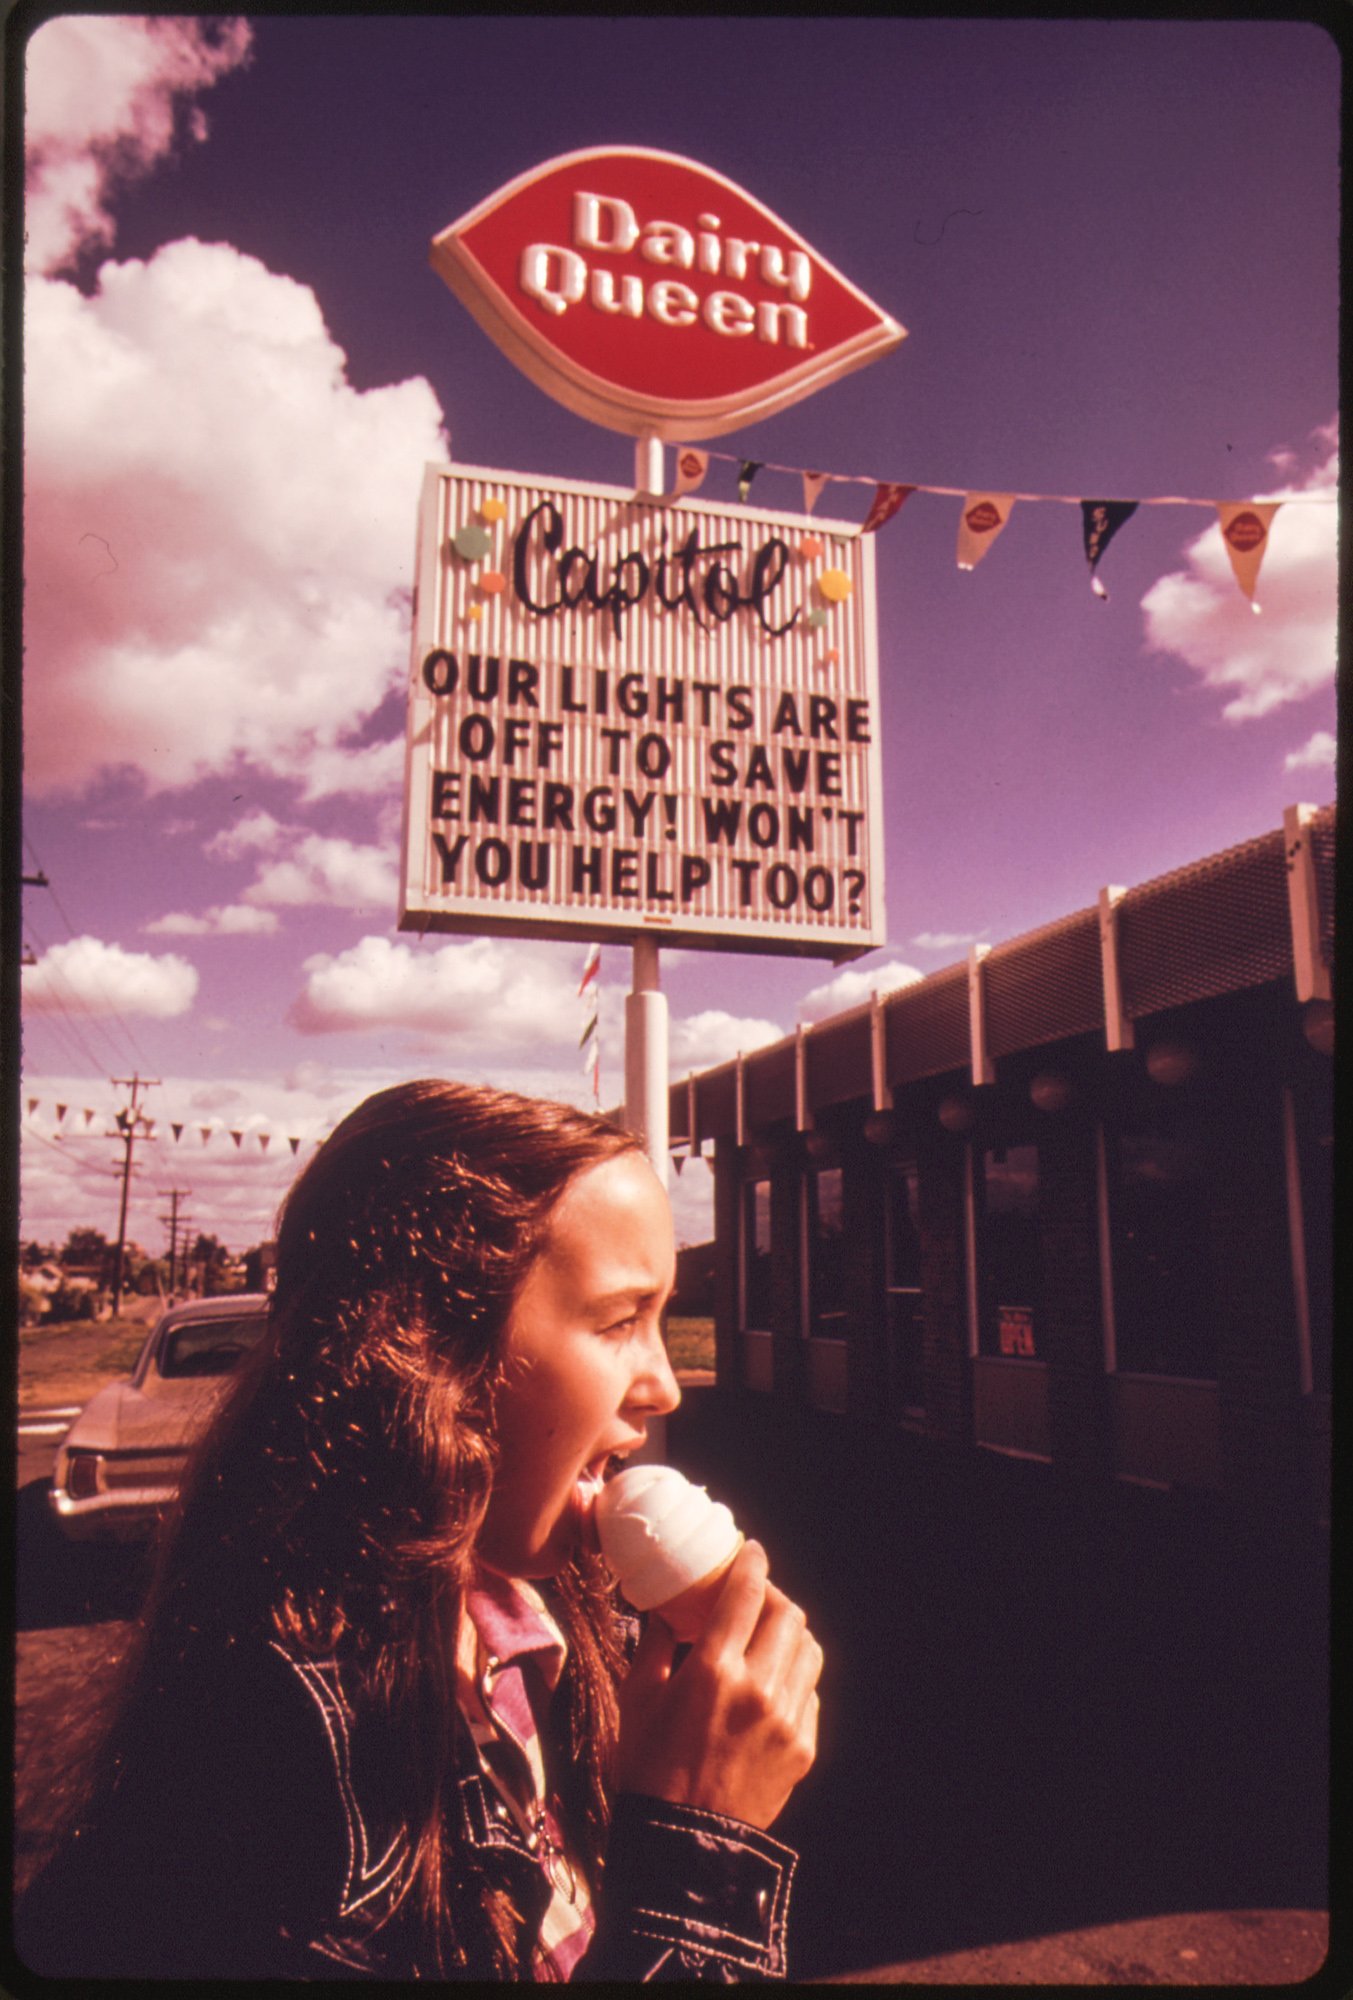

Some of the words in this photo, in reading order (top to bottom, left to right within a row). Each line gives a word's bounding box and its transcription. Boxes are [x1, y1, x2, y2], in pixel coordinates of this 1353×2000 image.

[573, 190, 811, 301] Dairy
[519, 243, 809, 349] Queen
[513, 500, 801, 642] Capitol
[423, 649, 539, 708] OUR
[561, 666, 754, 731] LIGHTS
[773, 693, 871, 743] ARE
[459, 713, 563, 768] OFF
[601, 727, 671, 779] TO
[709, 740, 842, 796] SAVE
[432, 771, 678, 840] ENERGY!
[703, 796, 865, 855] WON'T
[432, 832, 551, 890] YOU
[572, 844, 711, 901] HELP
[732, 859, 866, 914] TOO?
